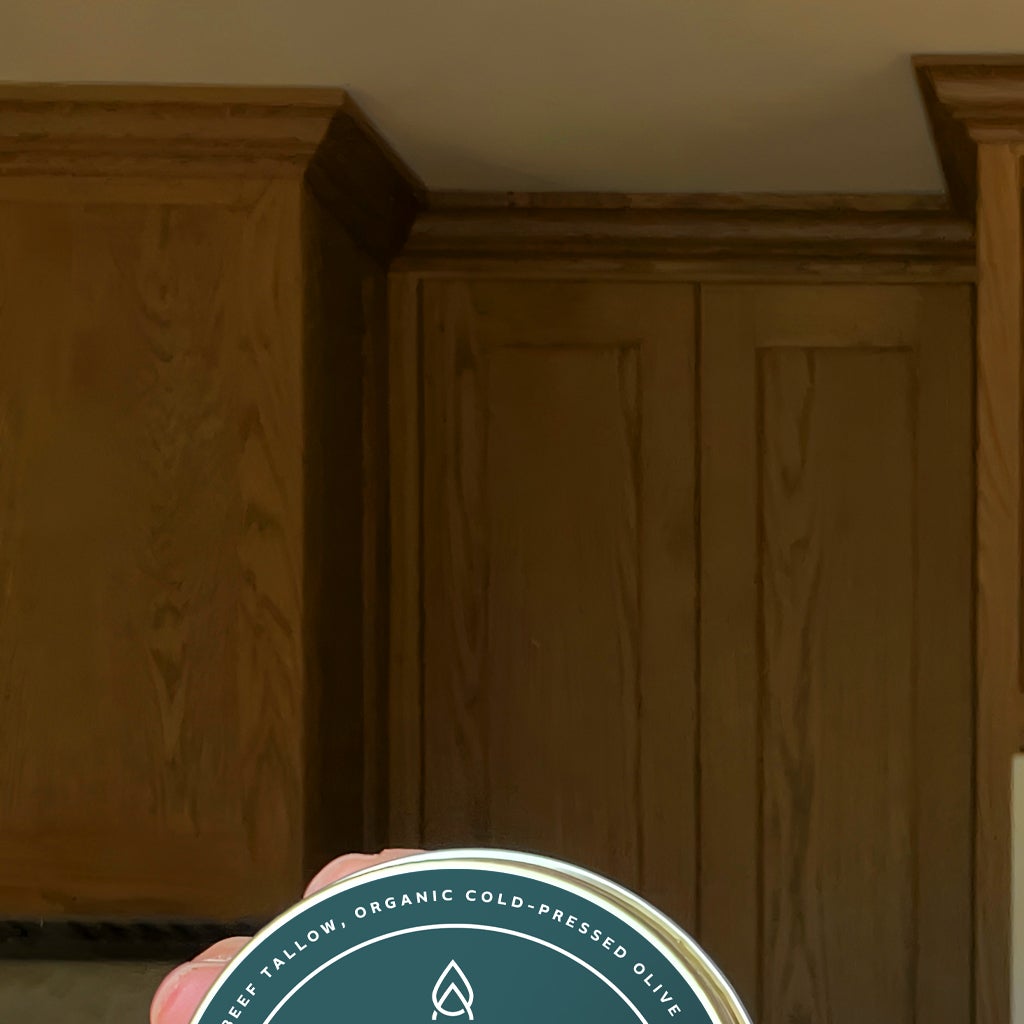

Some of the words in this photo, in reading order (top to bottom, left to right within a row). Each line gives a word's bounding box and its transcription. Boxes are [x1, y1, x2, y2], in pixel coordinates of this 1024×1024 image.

[259, 919, 346, 978] TALLOW,
[354, 889, 453, 919] ORGANIC
[465, 889, 627, 959] COLD-PRESSED
[633, 962, 682, 1017] OLIVE
